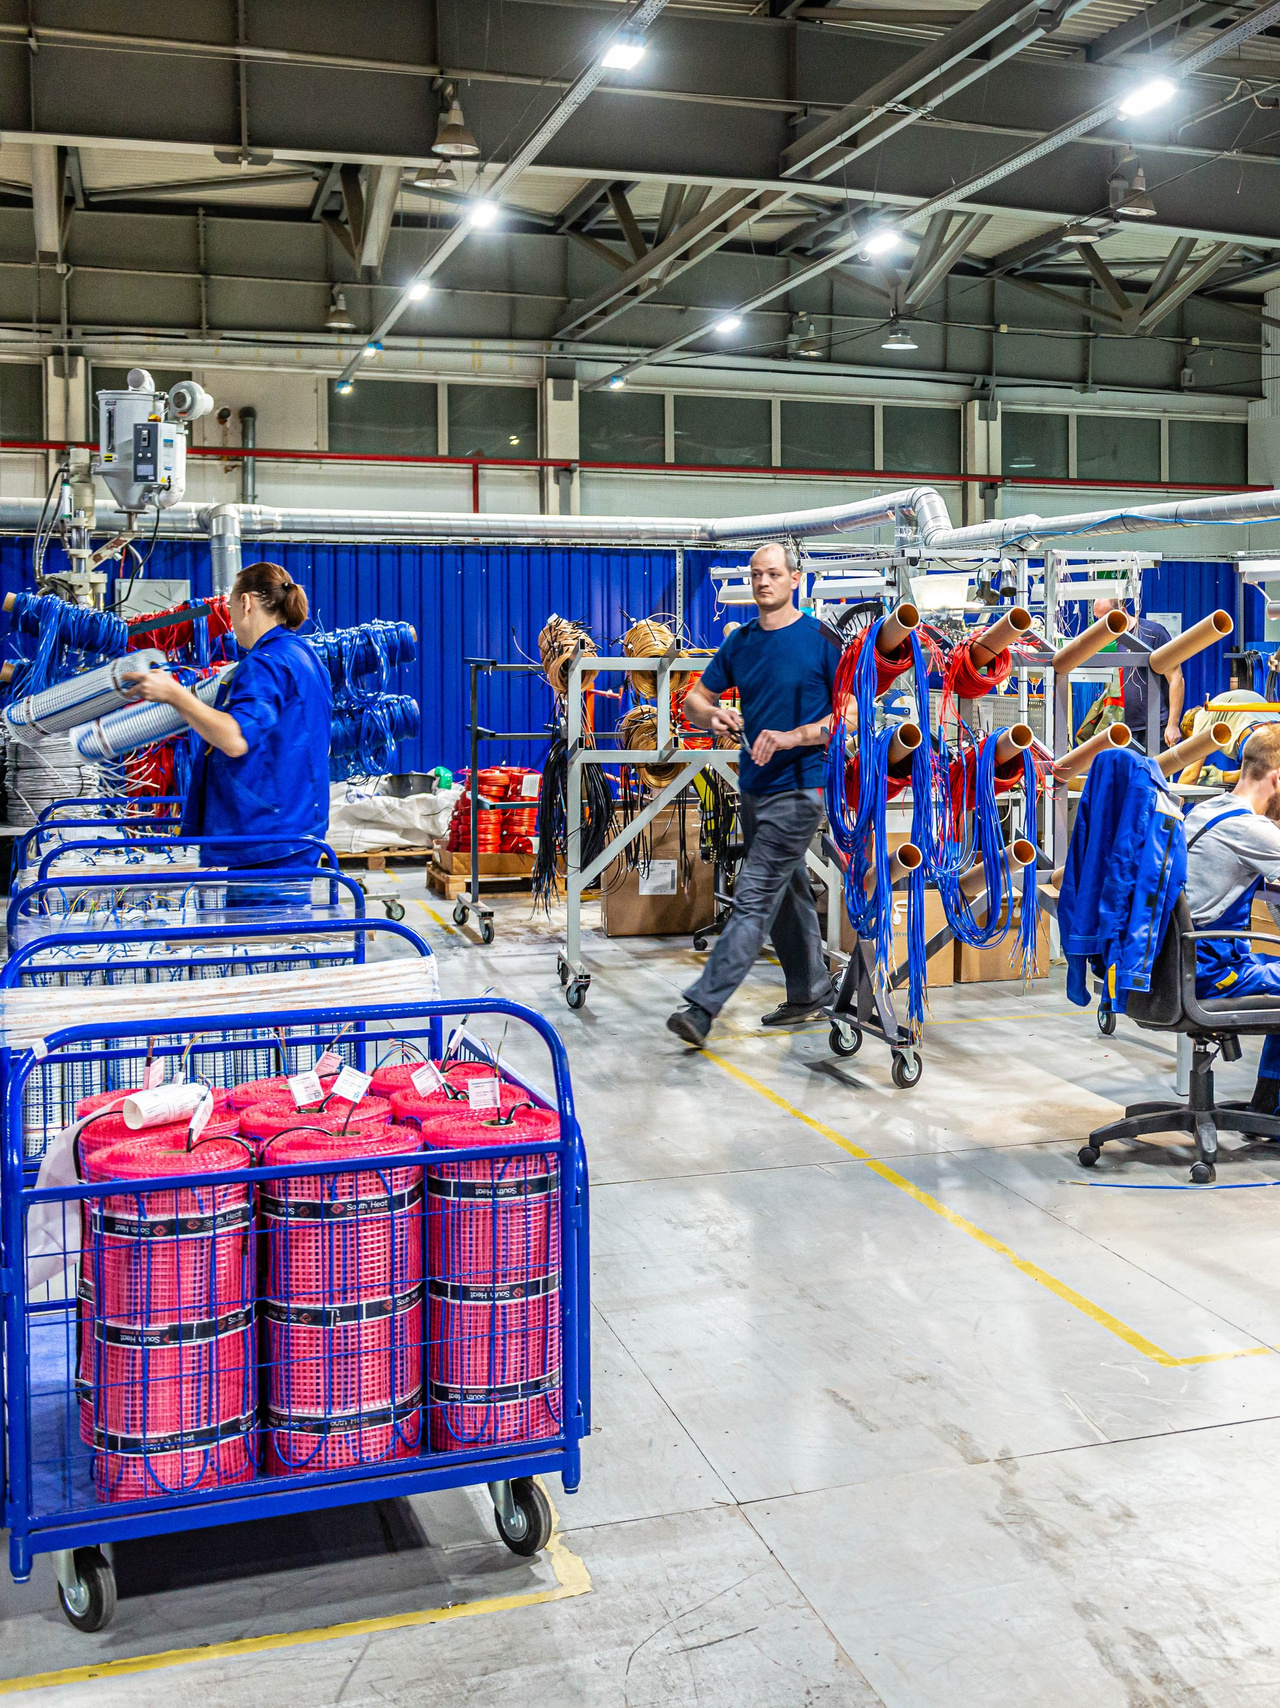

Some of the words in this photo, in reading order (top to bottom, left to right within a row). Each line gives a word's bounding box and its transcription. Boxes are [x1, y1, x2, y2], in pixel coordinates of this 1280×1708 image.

[475, 1188, 493, 1196] Heat
[496, 1186, 517, 1196] South
[347, 1202, 367, 1211] South
[370, 1199, 388, 1209] Heat
[131, 1226, 150, 1236] Soth
[470, 1291, 487, 1299] Heat
[120, 1334, 136, 1343] Heat
